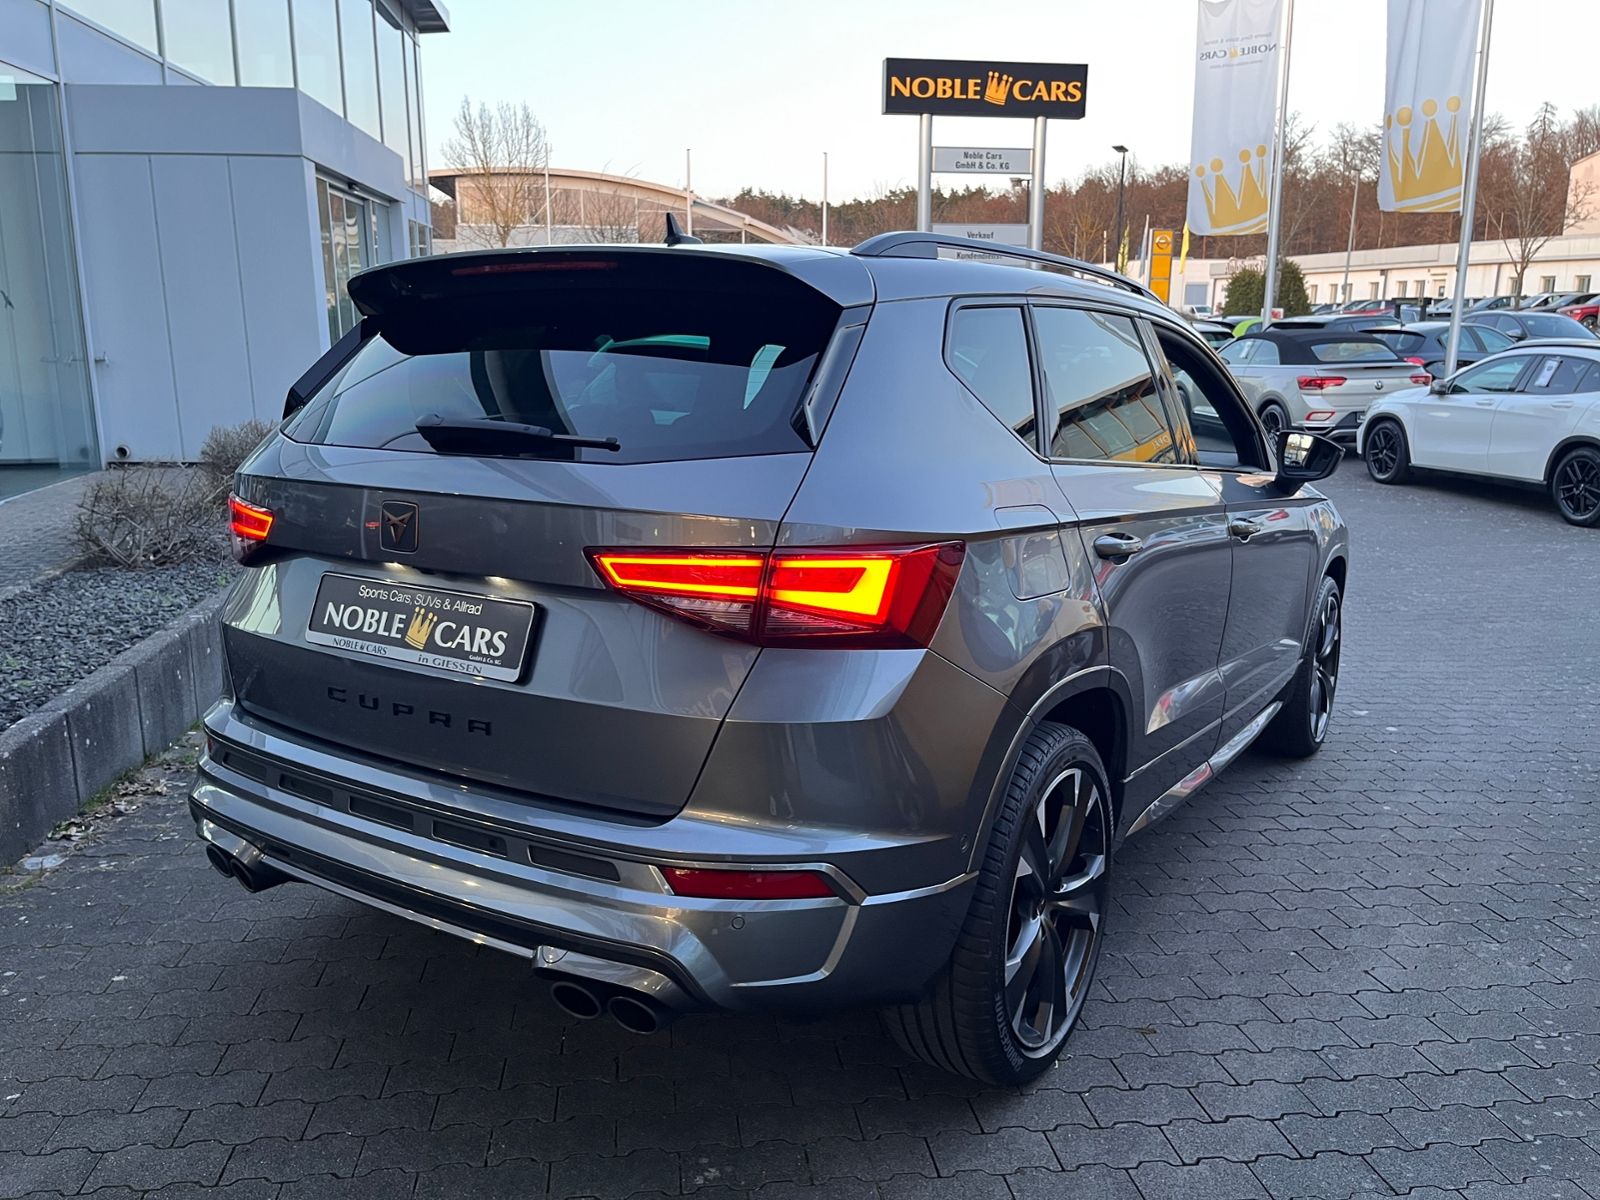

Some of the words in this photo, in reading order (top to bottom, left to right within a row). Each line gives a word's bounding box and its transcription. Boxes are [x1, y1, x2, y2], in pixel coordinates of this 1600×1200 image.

[890, 76, 982, 99] NOBLE
[1012, 80, 1083, 102] CARS
[955, 161, 976, 169] GmbH
[978, 161, 984, 170] &
[986, 161, 998, 170] Co.
[1000, 162, 1010, 170] KG
[963, 151, 984, 160] Noble
[985, 151, 1003, 160] Cars
[966, 231, 995, 239] Verkauf
[358, 584, 388, 600] Sports
[389, 589, 412, 605] Cars,
[414, 593, 442, 609] SUVs
[443, 598, 451, 610] &
[452, 600, 483, 615] Allrad
[323, 601, 407, 638] NOBLE
[434, 621, 508, 657] CARS
[333, 638, 359, 650] NOBLE
[366, 646, 388, 656] CARS
[418, 654, 429, 663] in
[432, 657, 483, 674] GIESSEN
[328, 687, 491, 736] CUPRA
